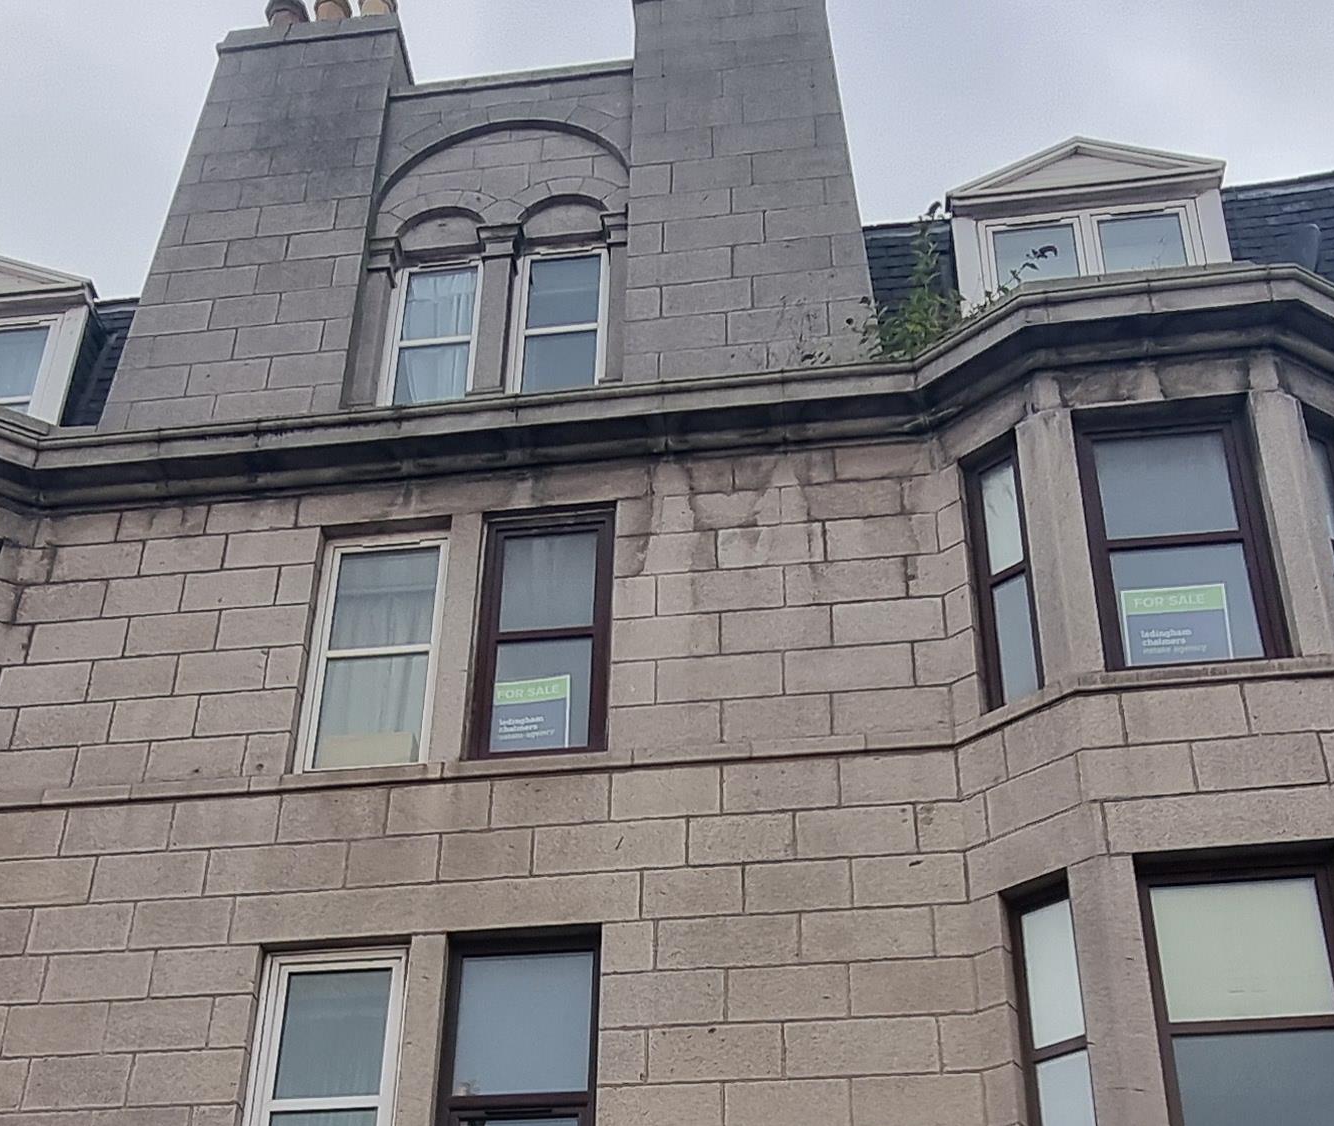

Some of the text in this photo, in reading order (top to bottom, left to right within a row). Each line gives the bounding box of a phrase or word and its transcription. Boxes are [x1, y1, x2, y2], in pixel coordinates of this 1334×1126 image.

[1134, 592, 1205, 609] FOR SALE
[497, 683, 561, 699] FOR SALE
